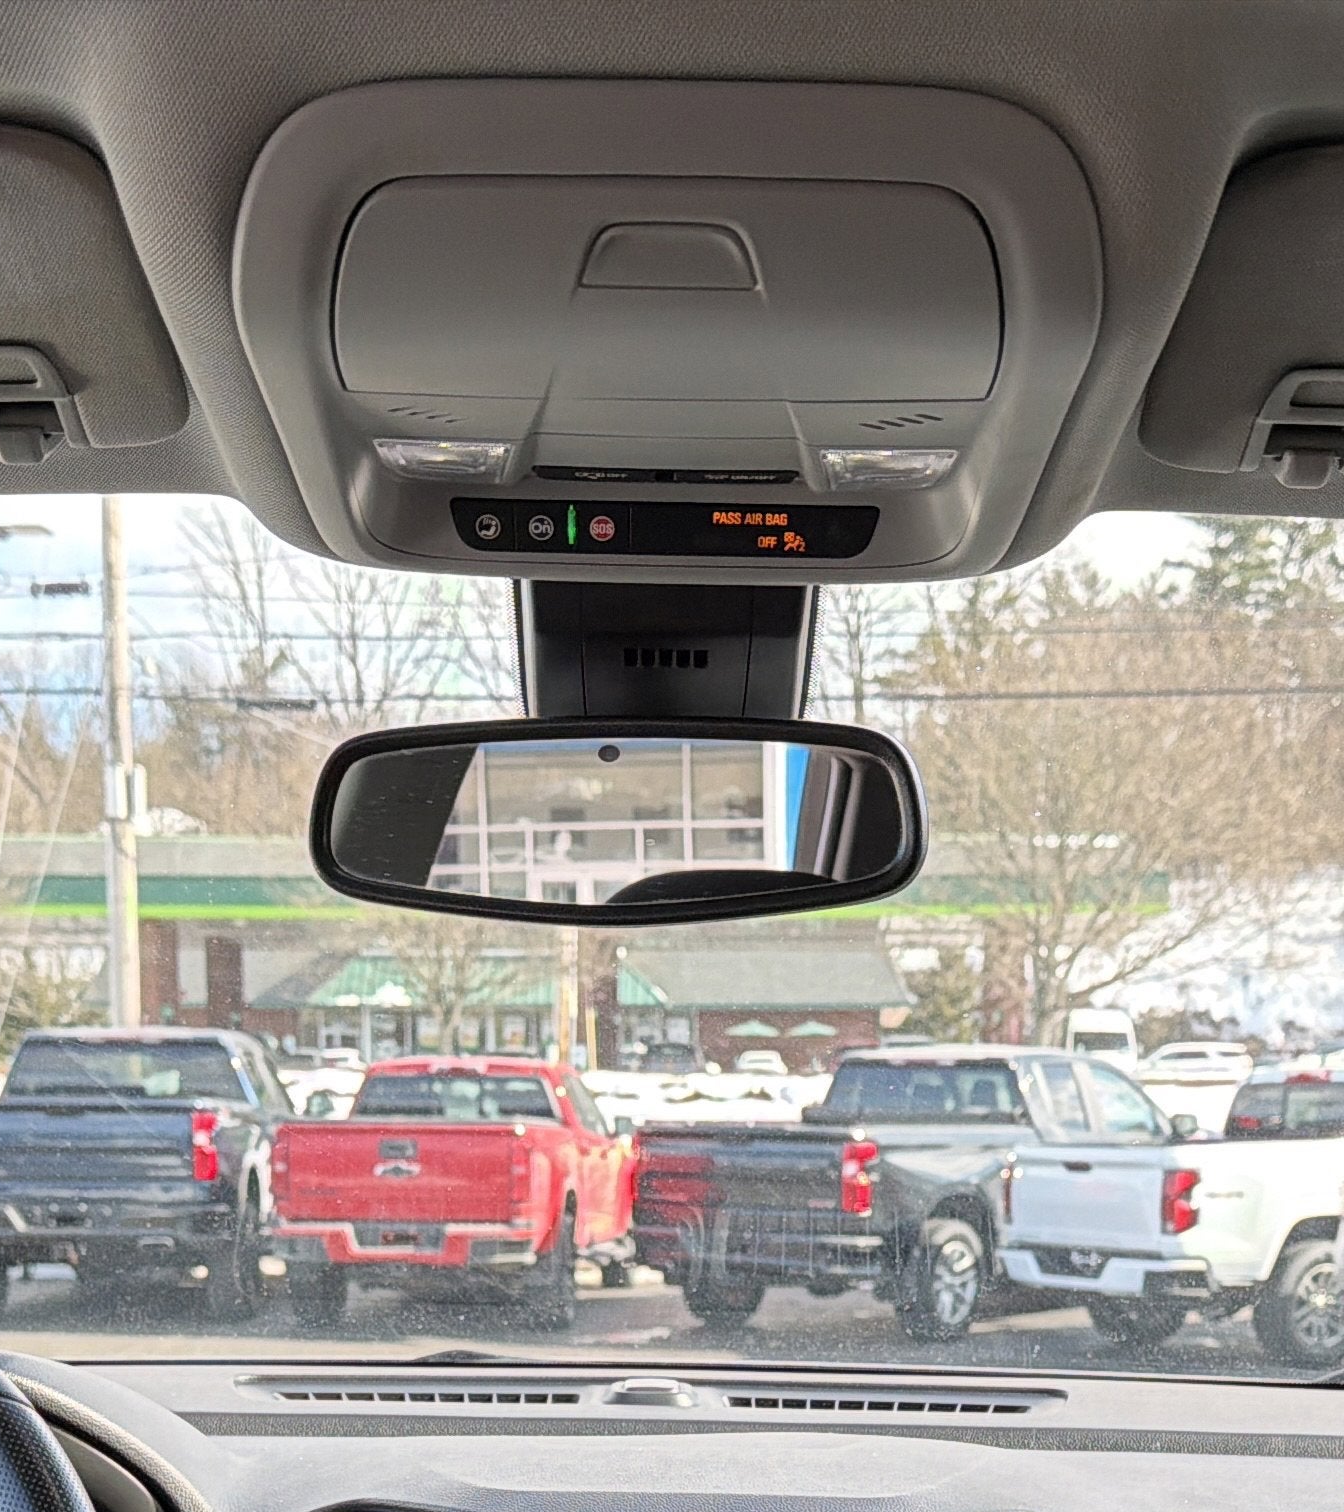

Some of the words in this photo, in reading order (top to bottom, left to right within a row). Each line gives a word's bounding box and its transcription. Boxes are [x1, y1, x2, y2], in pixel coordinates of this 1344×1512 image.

[713, 512, 741, 525] PASS
[744, 513, 763, 525] AIR
[765, 513, 788, 526] BAG
[592, 522, 613, 535] SOS
[757, 536, 778, 548] OFF
